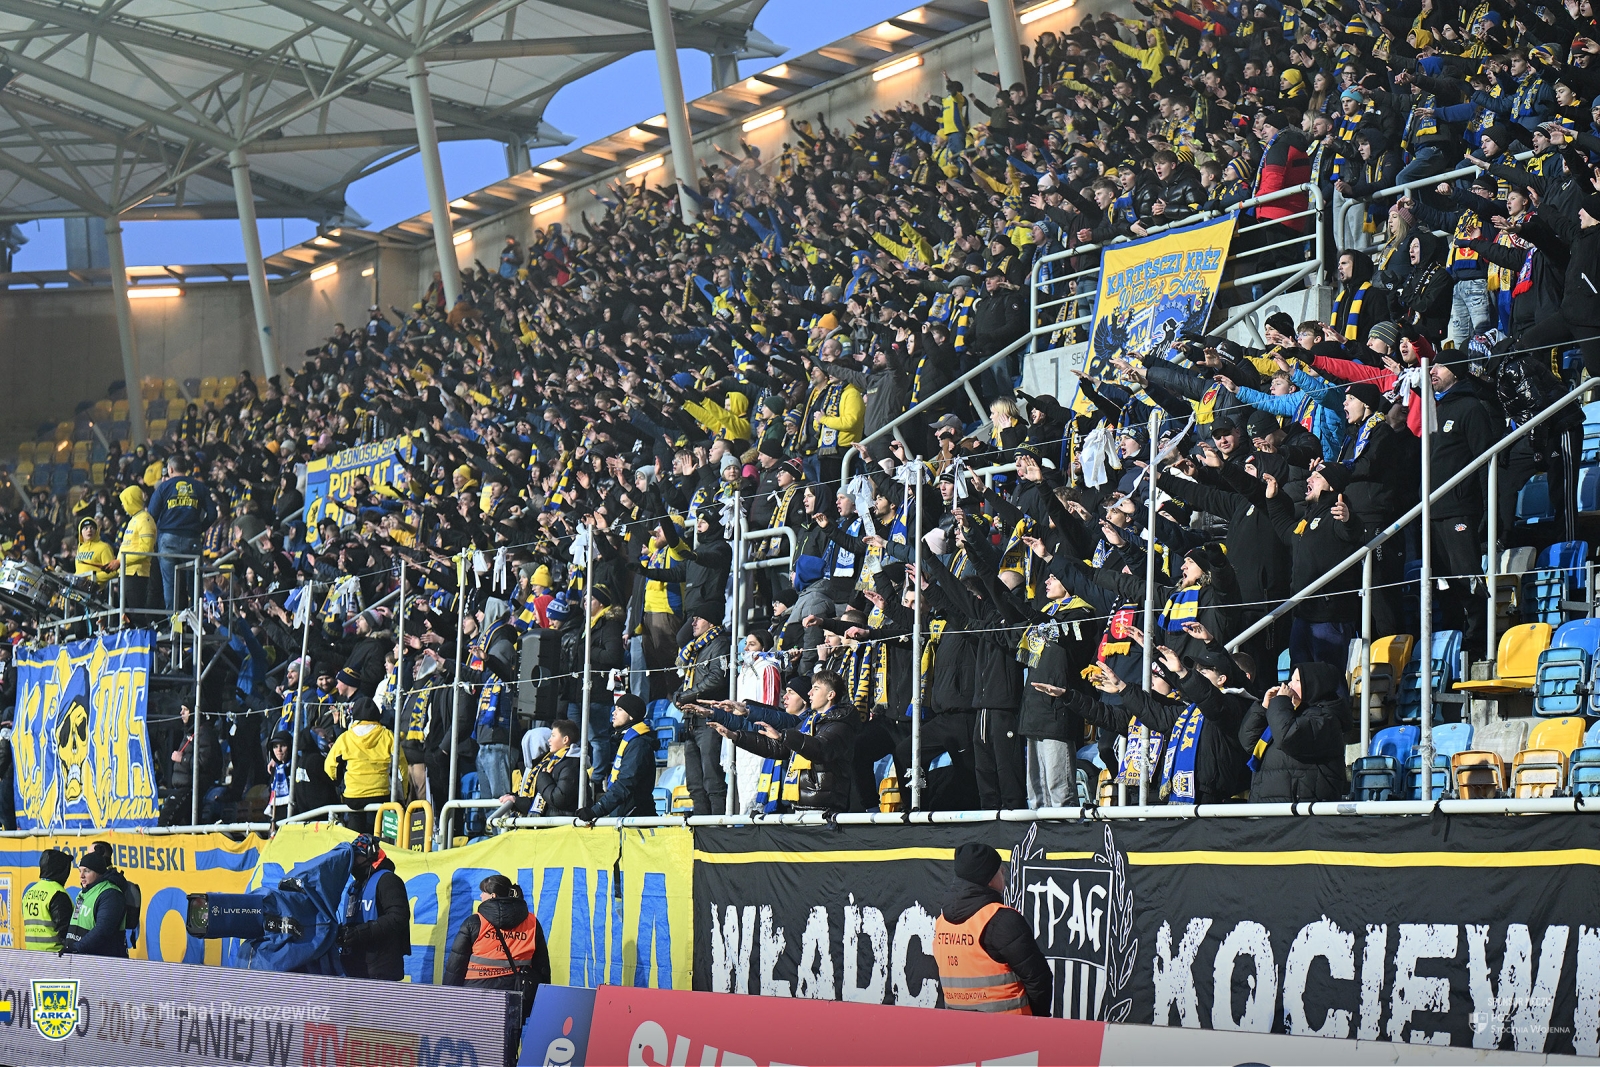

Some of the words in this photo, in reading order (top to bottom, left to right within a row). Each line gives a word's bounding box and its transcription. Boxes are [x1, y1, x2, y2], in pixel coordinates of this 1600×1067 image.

[325, 454, 335, 471] W
[111, 843, 186, 872] IEBIESKI
[1027, 876, 1108, 953] TPAG
[711, 893, 938, 1008] WŁADC
[937, 932, 975, 946] STEWARD
[947, 955, 959, 967] 108
[175, 1009, 255, 1063] TANIEJ
[265, 1020, 294, 1067] W
